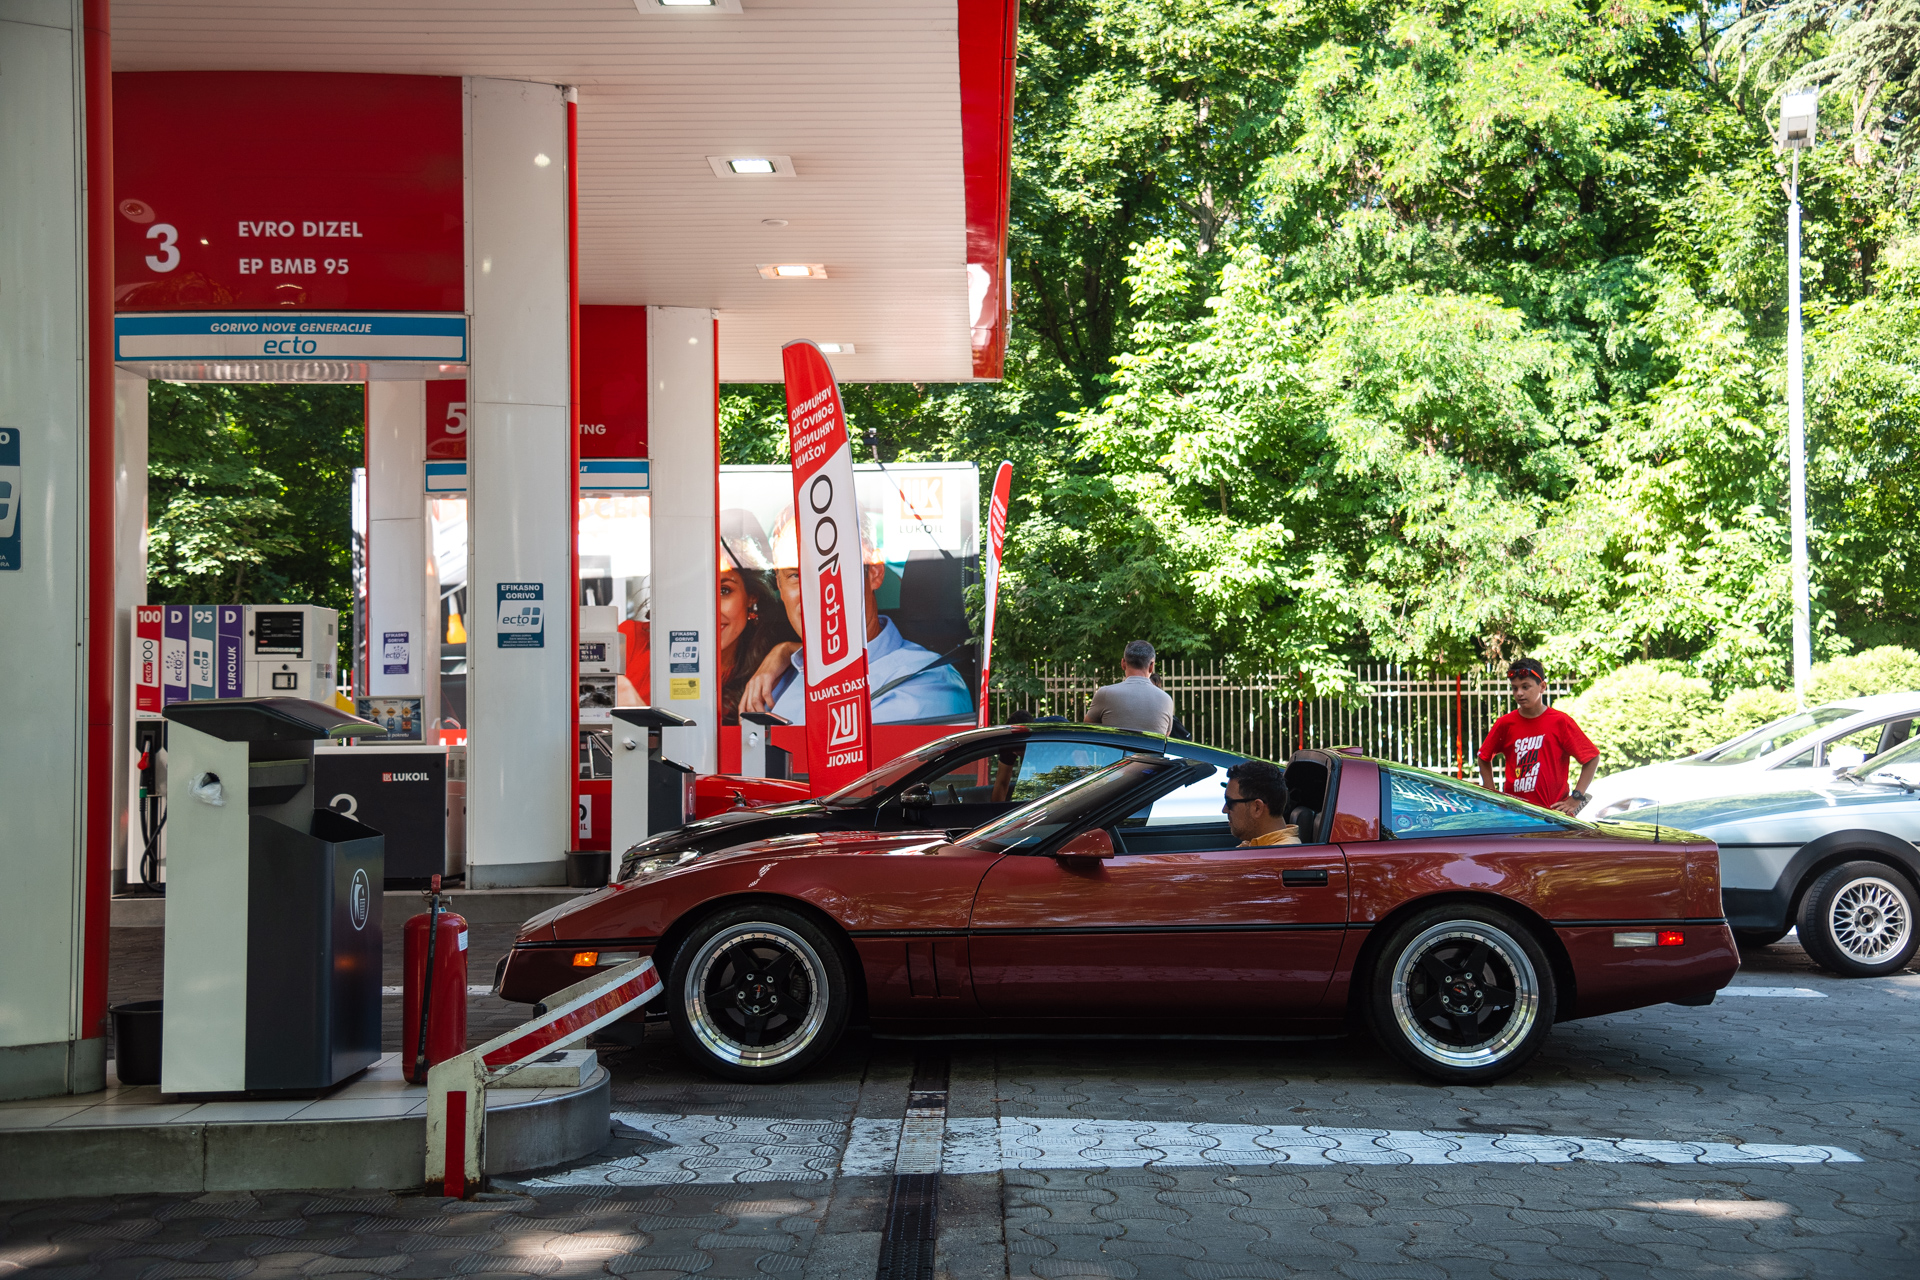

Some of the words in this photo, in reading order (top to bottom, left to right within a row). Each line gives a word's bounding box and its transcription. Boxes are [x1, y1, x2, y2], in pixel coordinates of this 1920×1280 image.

[238, 221, 295, 238] EVRO
[302, 221, 363, 238] DIZEL
[145, 223, 181, 273] 3
[239, 258, 263, 275] EP
[270, 258, 317, 275] BMB
[324, 258, 350, 275] 95
[210, 322, 259, 333] GORIVO
[262, 322, 297, 333] NOVE
[299, 322, 373, 334] GENERACIJE
[263, 336, 317, 355] ecto
[445, 402, 466, 434] 5
[899, 524, 943, 534] LUKOIL
[139, 610, 162, 624] 100
[170, 610, 183, 624] D
[194, 610, 213, 624] 95
[224, 610, 237, 624] D
[502, 614, 530, 625] ecto
[173, 659, 182, 682] ecto
[200, 659, 209, 682] ecto
[227, 646, 237, 691] EUROLUK
[1514, 734, 1544, 753] SCUD
[392, 772, 430, 781] LUKOIL
[1513, 775, 1538, 792] RARI
